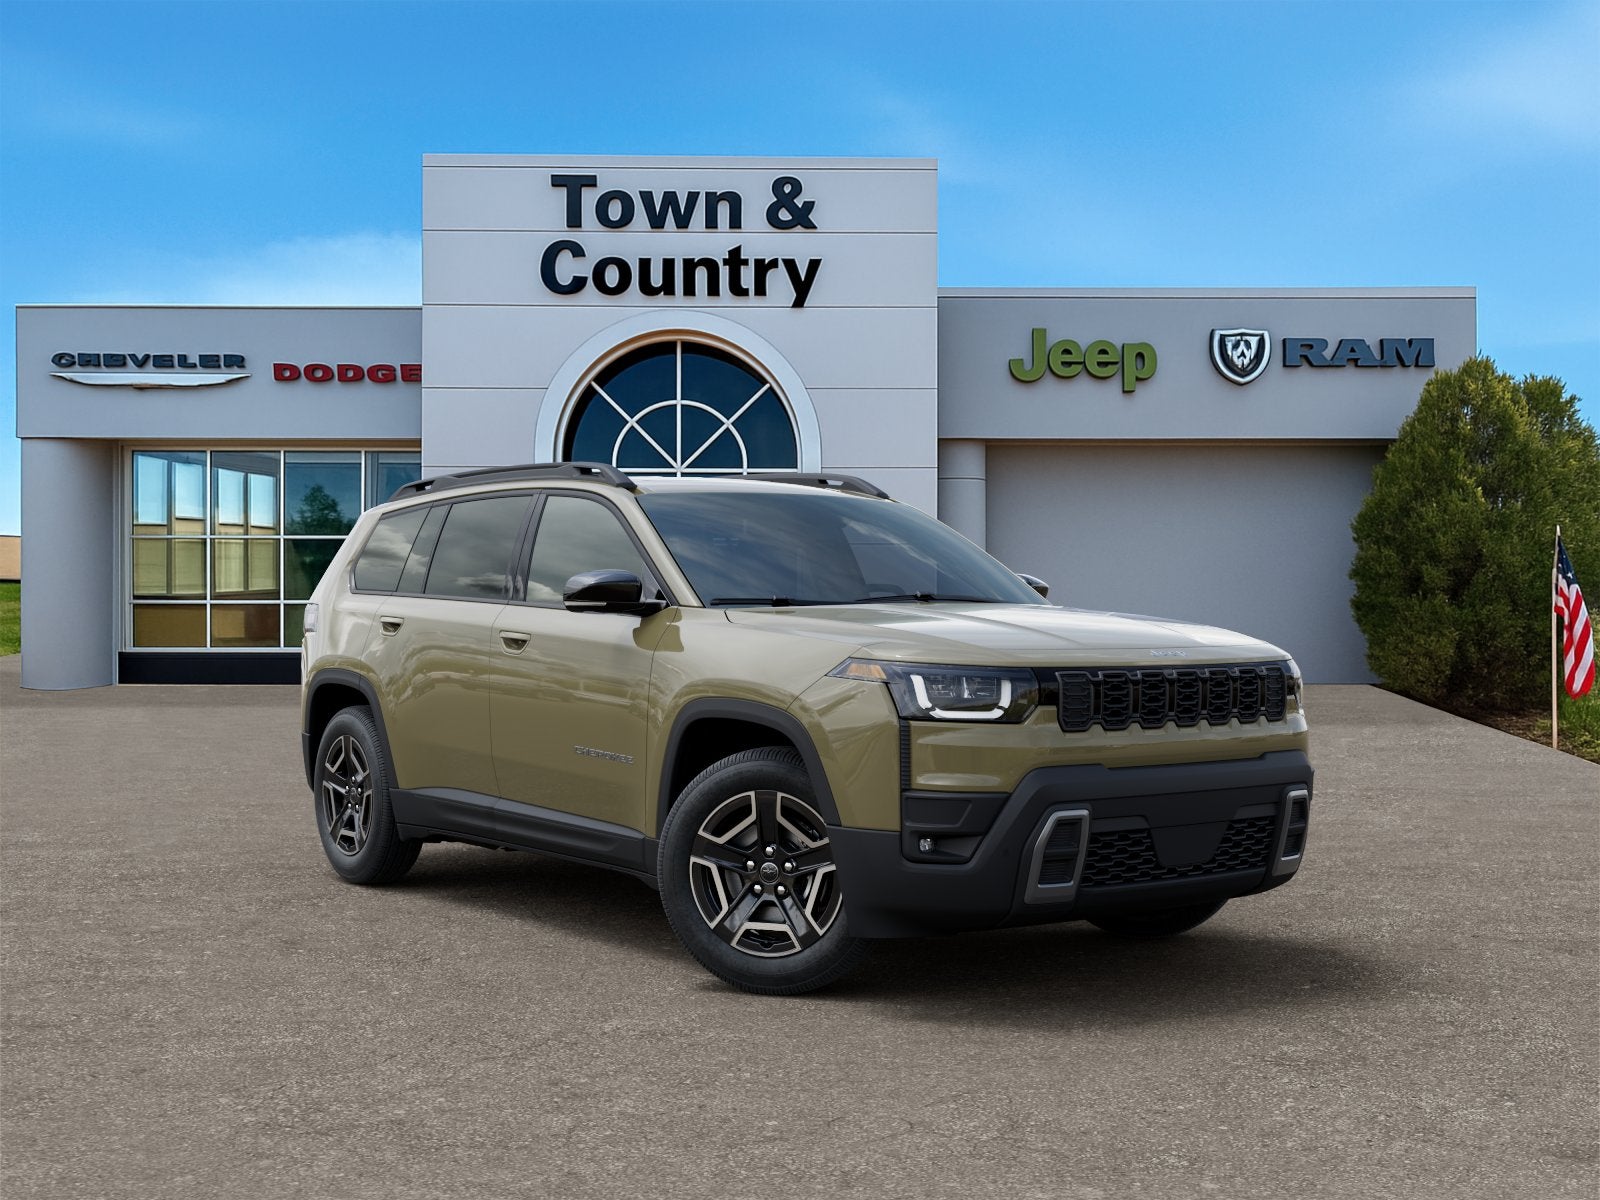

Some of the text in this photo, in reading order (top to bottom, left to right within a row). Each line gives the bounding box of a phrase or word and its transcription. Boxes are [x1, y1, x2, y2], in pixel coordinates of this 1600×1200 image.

[550, 174, 818, 230] Town &
[540, 239, 822, 308] Country
[273, 363, 422, 383] DODGE
[1009, 327, 1157, 393] Jeep
[1282, 337, 1435, 368] RAM
